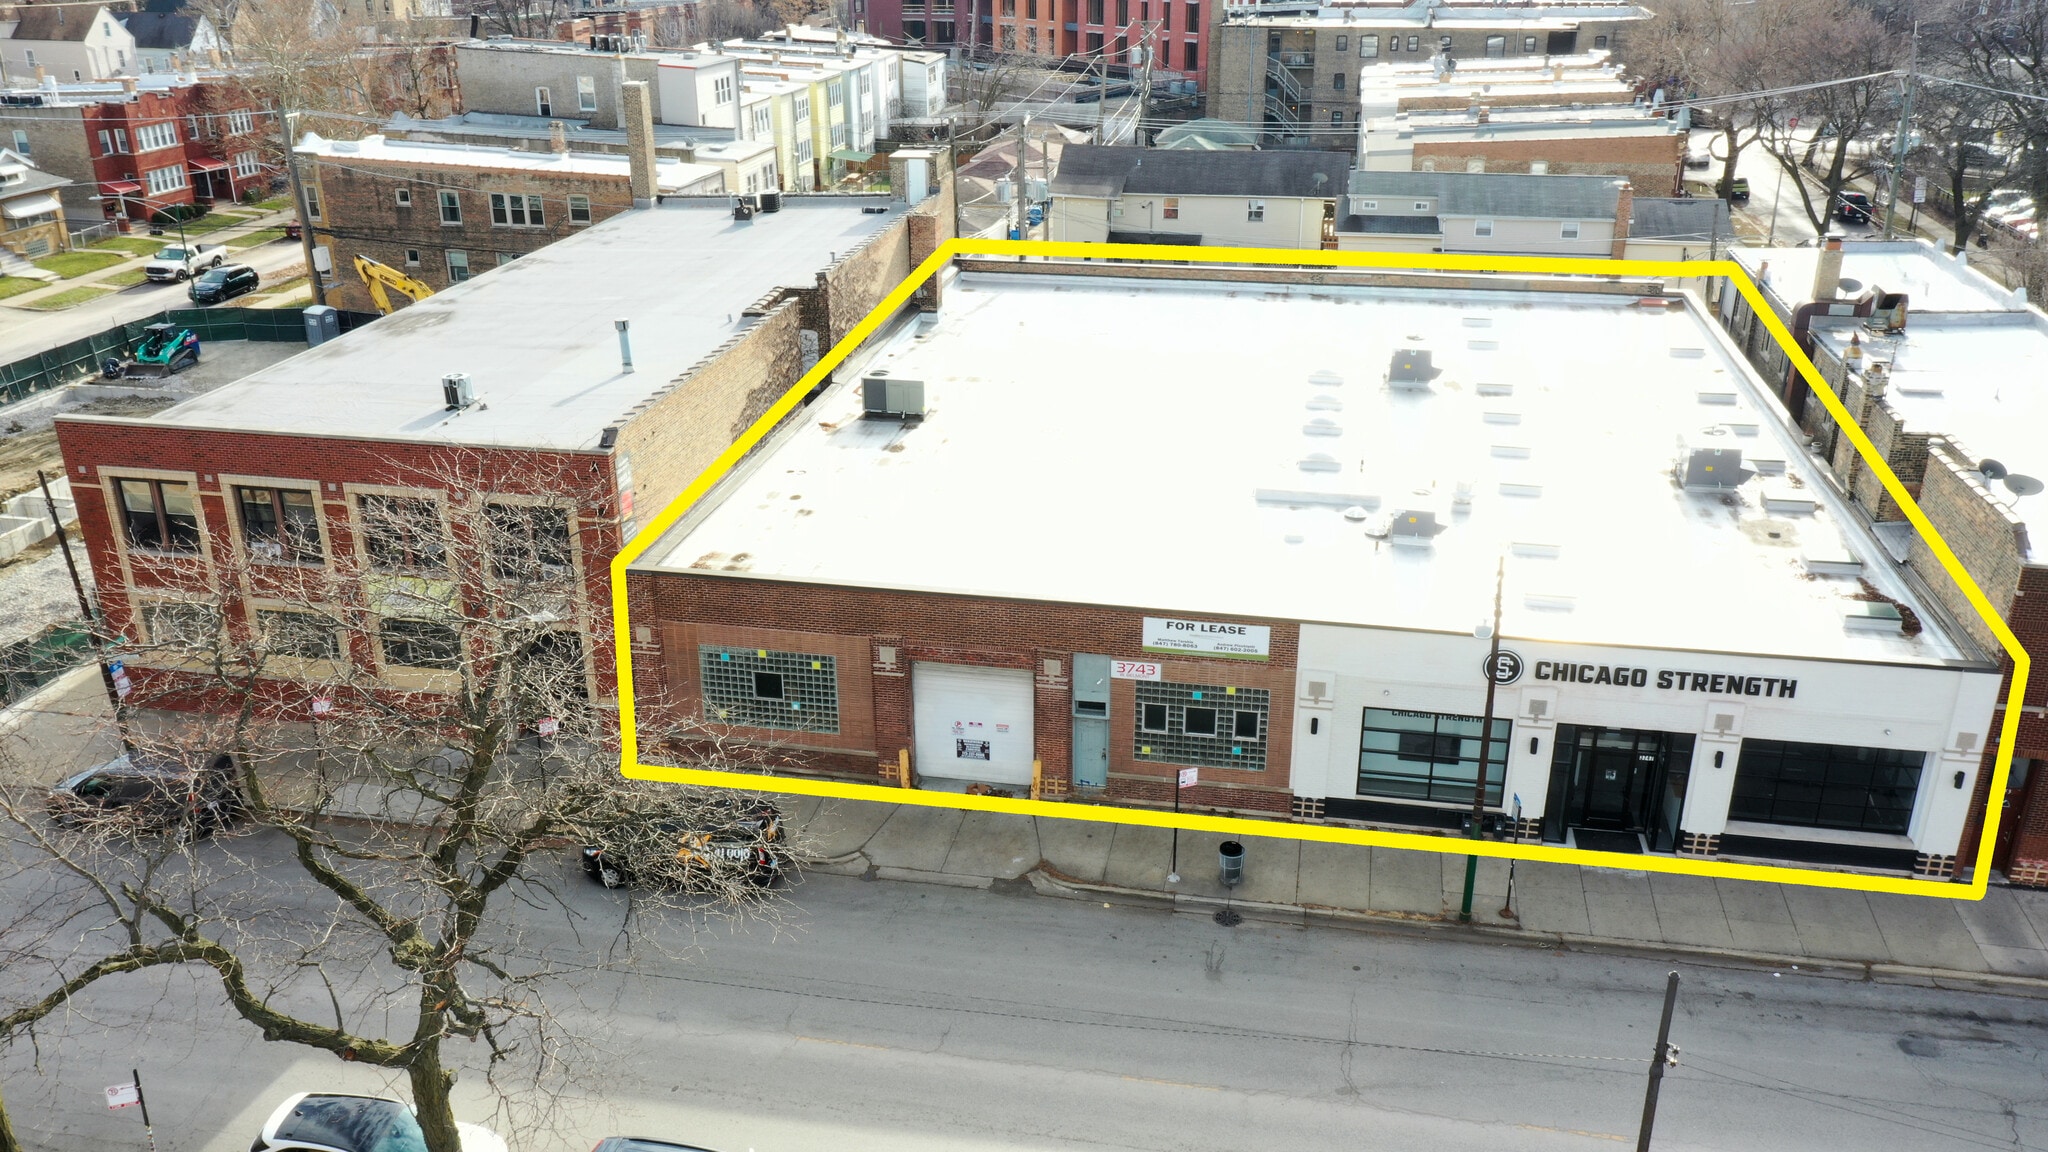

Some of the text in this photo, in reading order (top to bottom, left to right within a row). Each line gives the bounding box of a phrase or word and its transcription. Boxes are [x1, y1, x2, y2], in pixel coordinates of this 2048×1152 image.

[1166, 621, 1247, 635] FOR LEASE
[1117, 662, 1156, 675] 3743
[1535, 660, 1798, 699] CHICAGO STRENGTH
